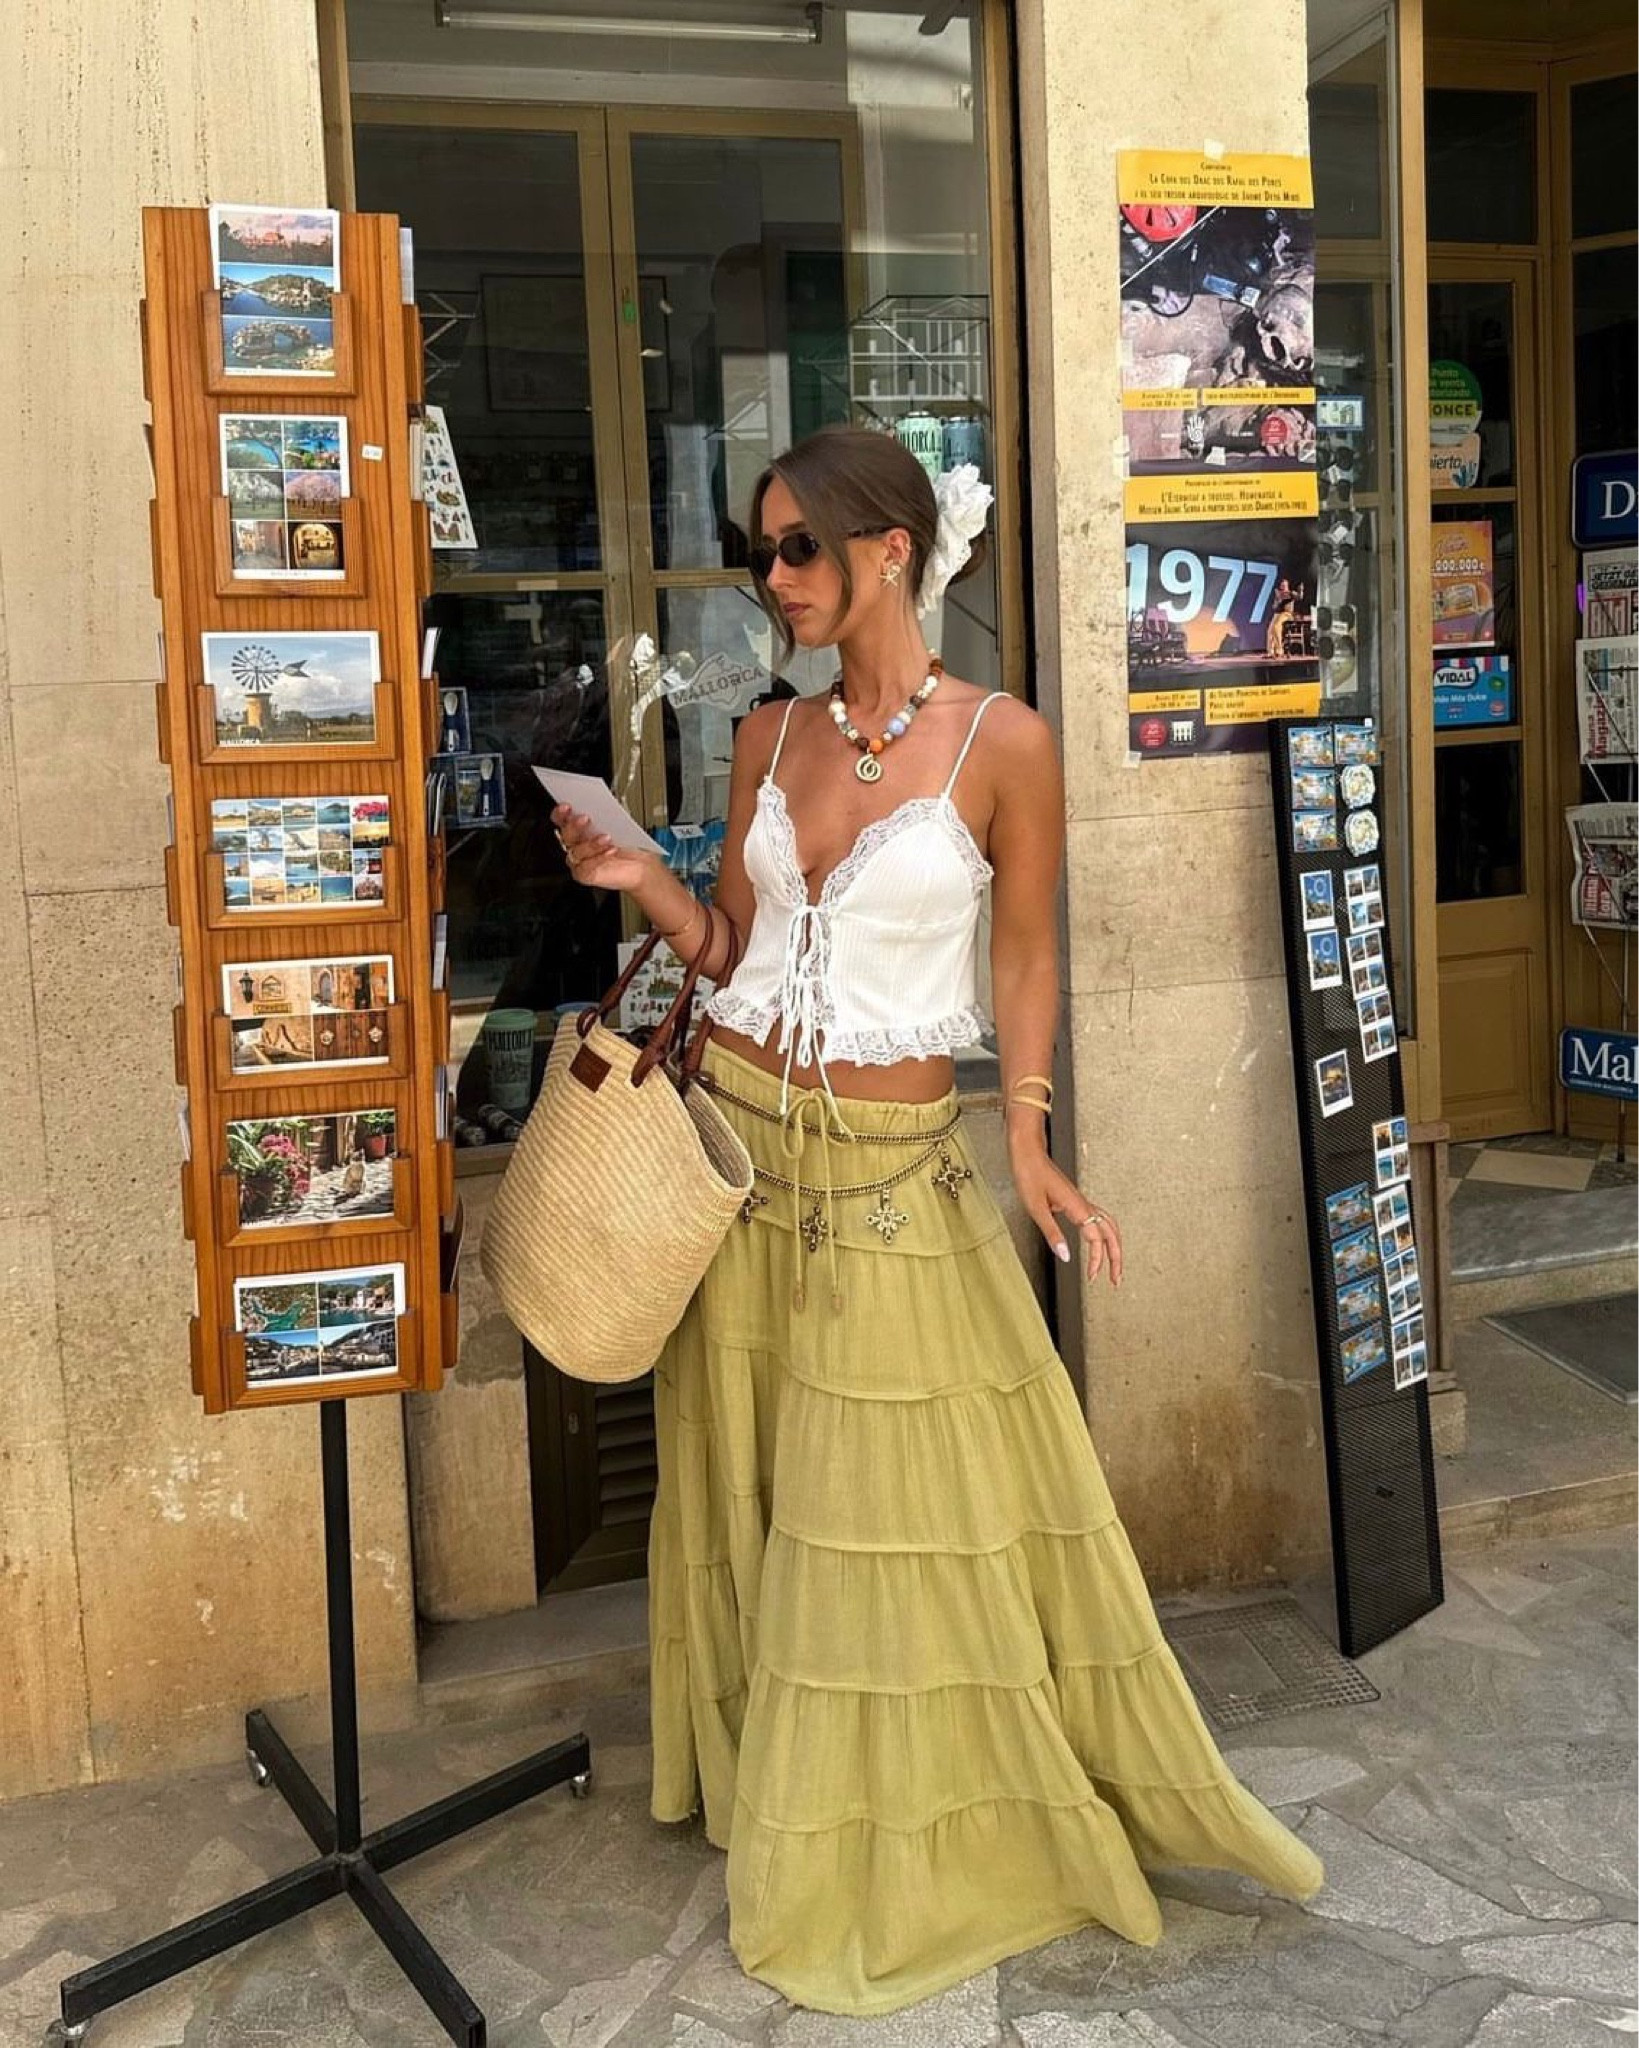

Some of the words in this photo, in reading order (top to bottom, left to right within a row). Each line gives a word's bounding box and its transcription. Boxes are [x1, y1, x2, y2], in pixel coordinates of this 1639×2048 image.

[1433, 404, 1473, 417] ONCE
[1600, 480, 1638, 520] D
[1125, 543, 1278, 624] 1977
[1436, 671, 1472, 683] VIDAL
